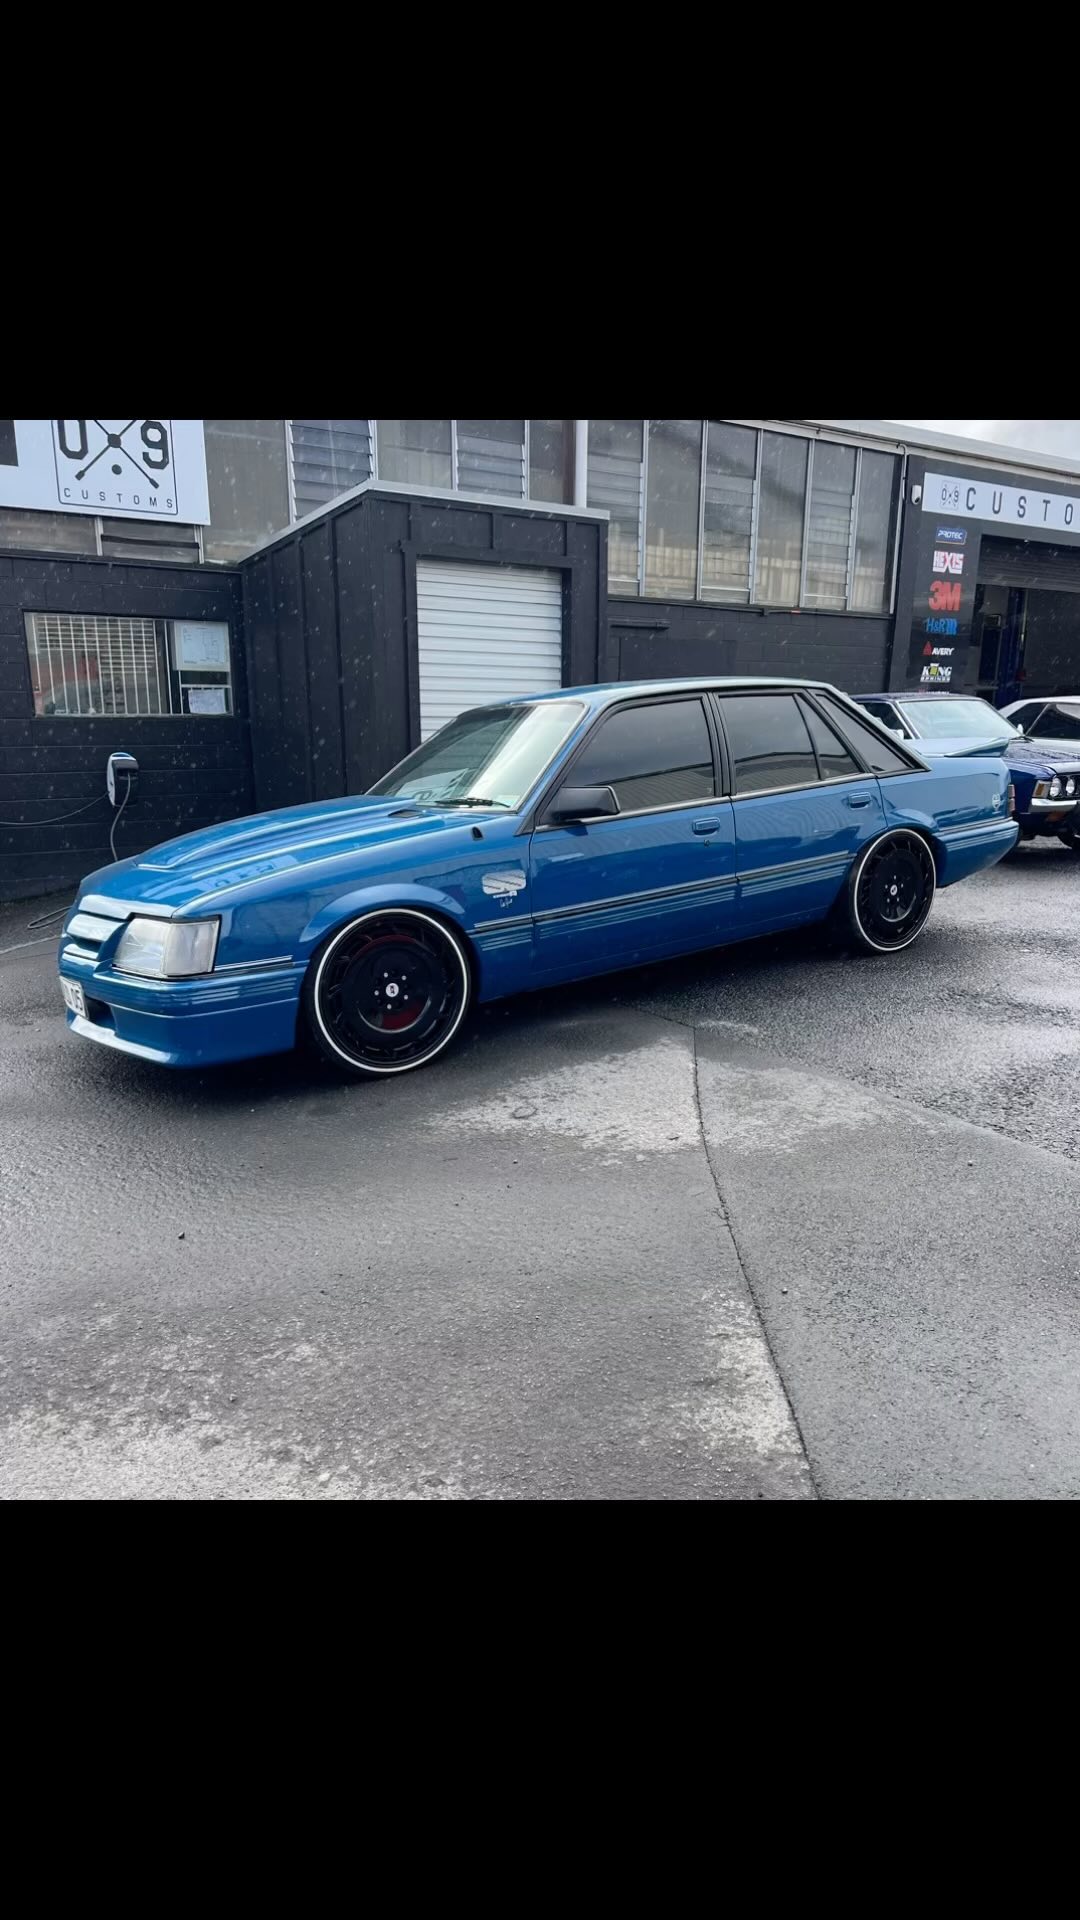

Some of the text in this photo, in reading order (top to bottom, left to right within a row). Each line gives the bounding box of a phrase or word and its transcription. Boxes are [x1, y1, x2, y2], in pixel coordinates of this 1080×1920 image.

[63, 487, 173, 509] CUSTOMS
[965, 487, 1074, 525] CUSTO
[937, 530, 963, 540] PROTEC
[932, 550, 964, 575] HEXIS
[928, 581, 962, 611] 3M
[931, 647, 955, 656] AVERY
